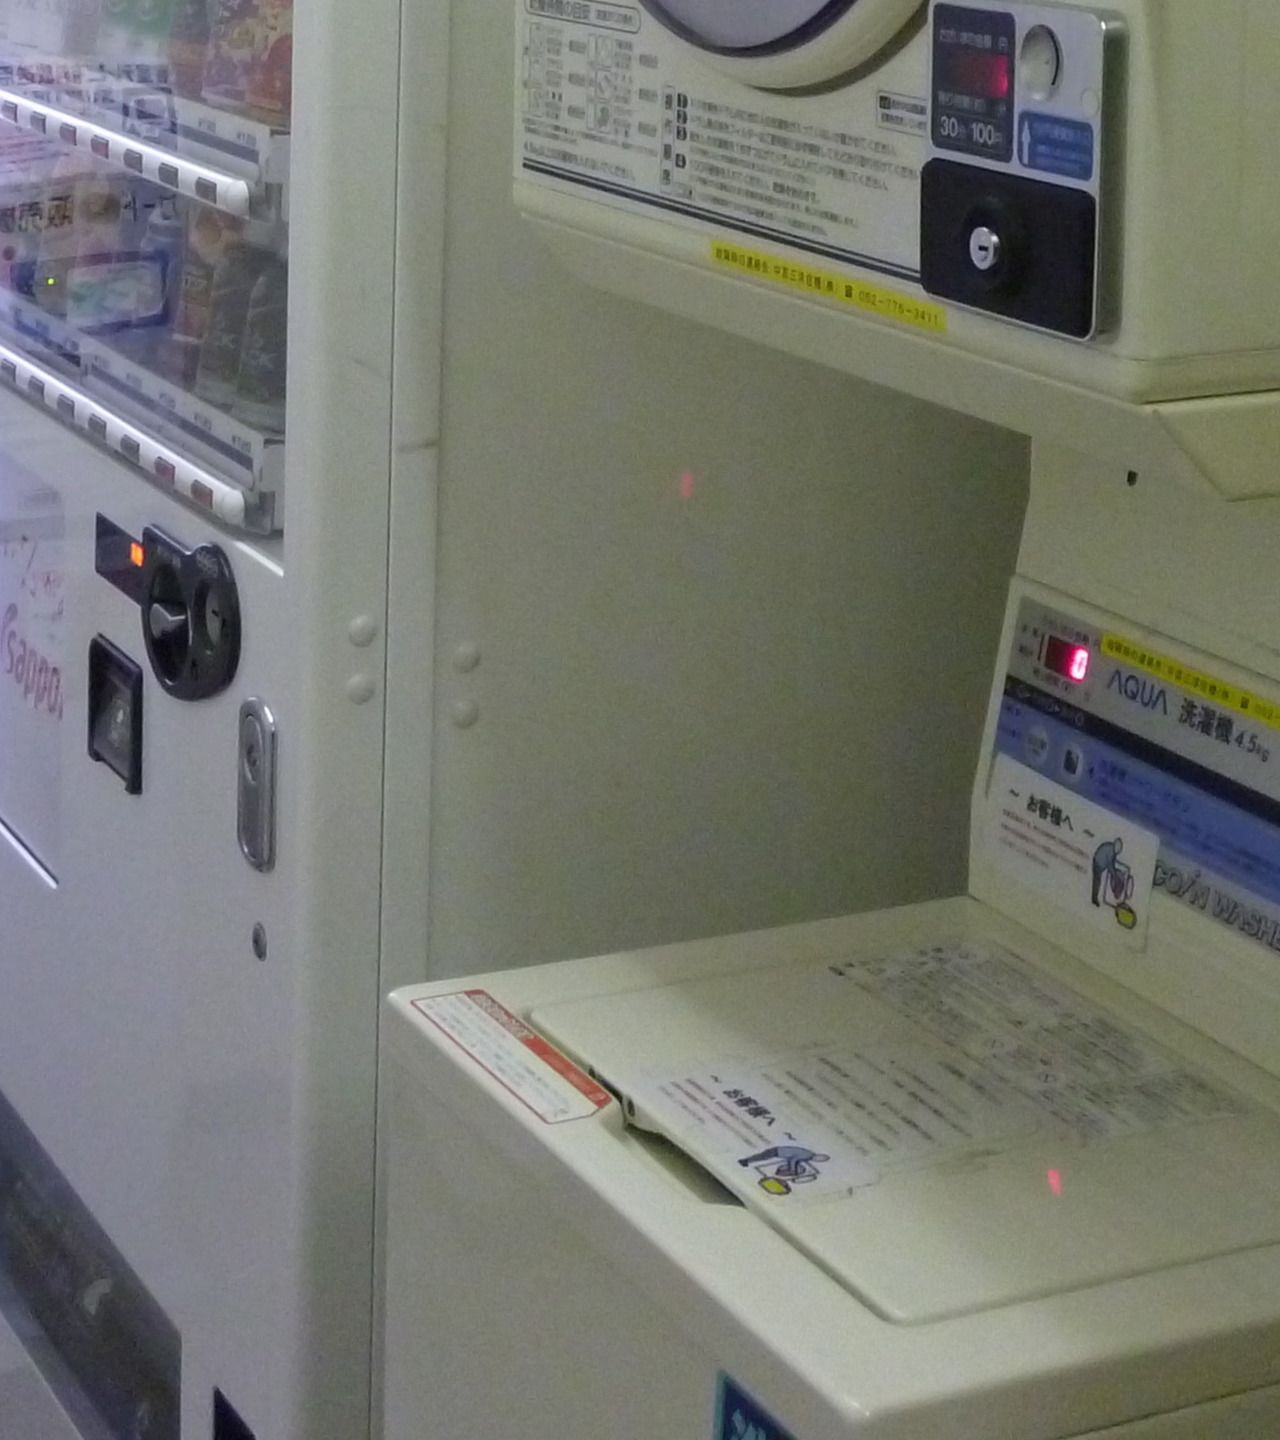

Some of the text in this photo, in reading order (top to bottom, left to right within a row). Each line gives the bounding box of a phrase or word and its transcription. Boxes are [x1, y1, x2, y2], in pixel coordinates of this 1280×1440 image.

[1070, 648, 1090, 681] 0
[1179, 697, 1234, 746] 洗濯機
